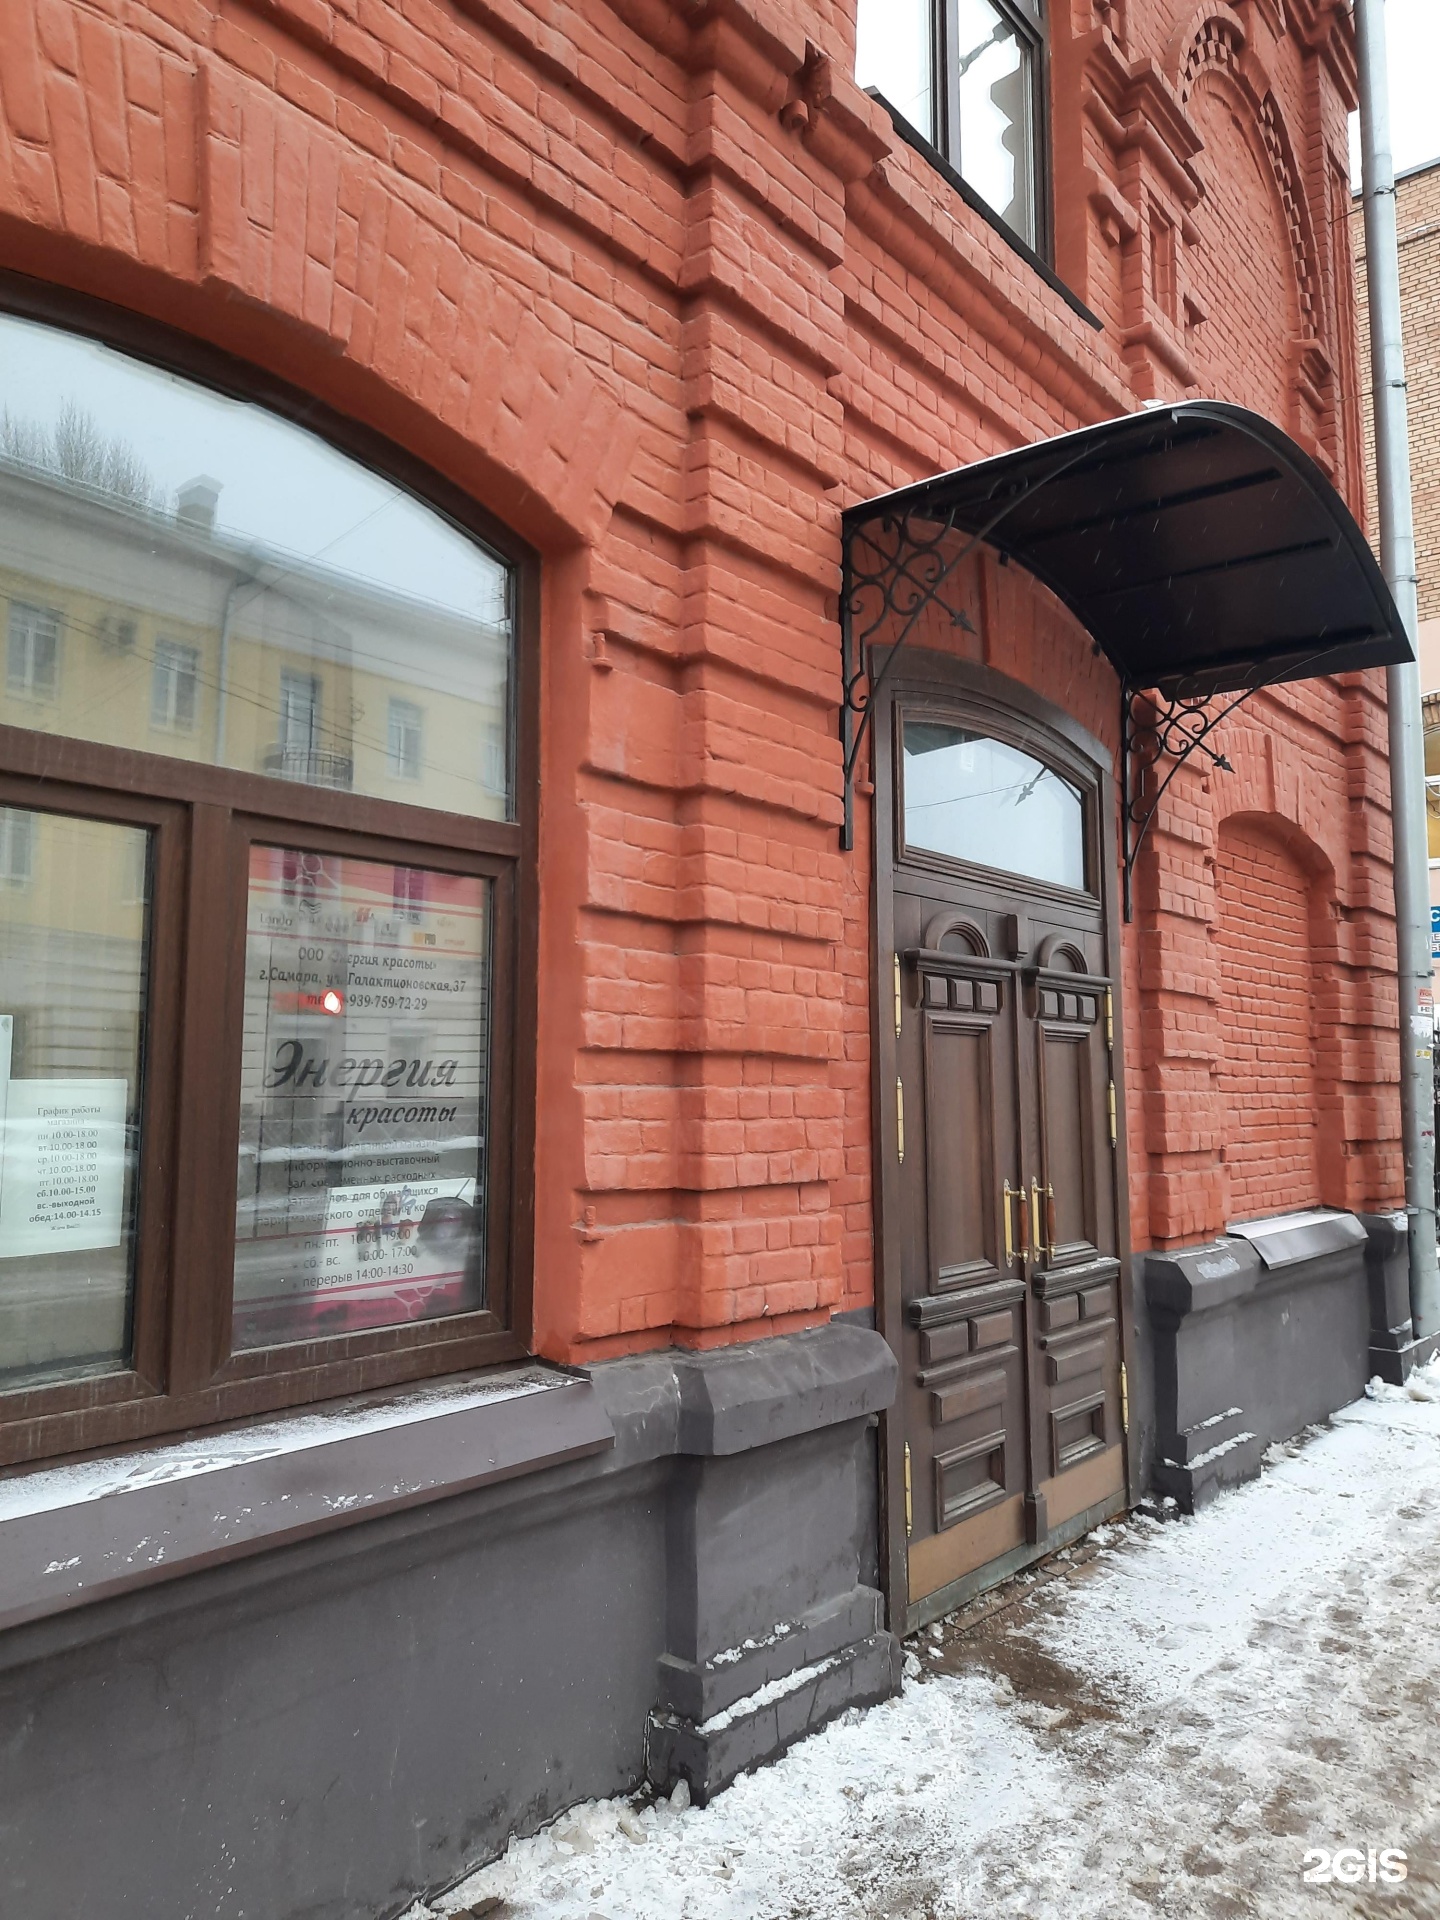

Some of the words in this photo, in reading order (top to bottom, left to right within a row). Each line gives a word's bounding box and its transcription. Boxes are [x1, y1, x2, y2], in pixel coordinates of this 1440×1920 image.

[298, 947, 324, 961] ООО
[263, 1038, 460, 1103] Энергия
[37, 1107, 69, 1118] График
[71, 1105, 101, 1117] работы
[346, 1106, 458, 1133] красоты
[303, 1273, 353, 1288] перерыв
[356, 1263, 414, 1280] 14:00-14:30
